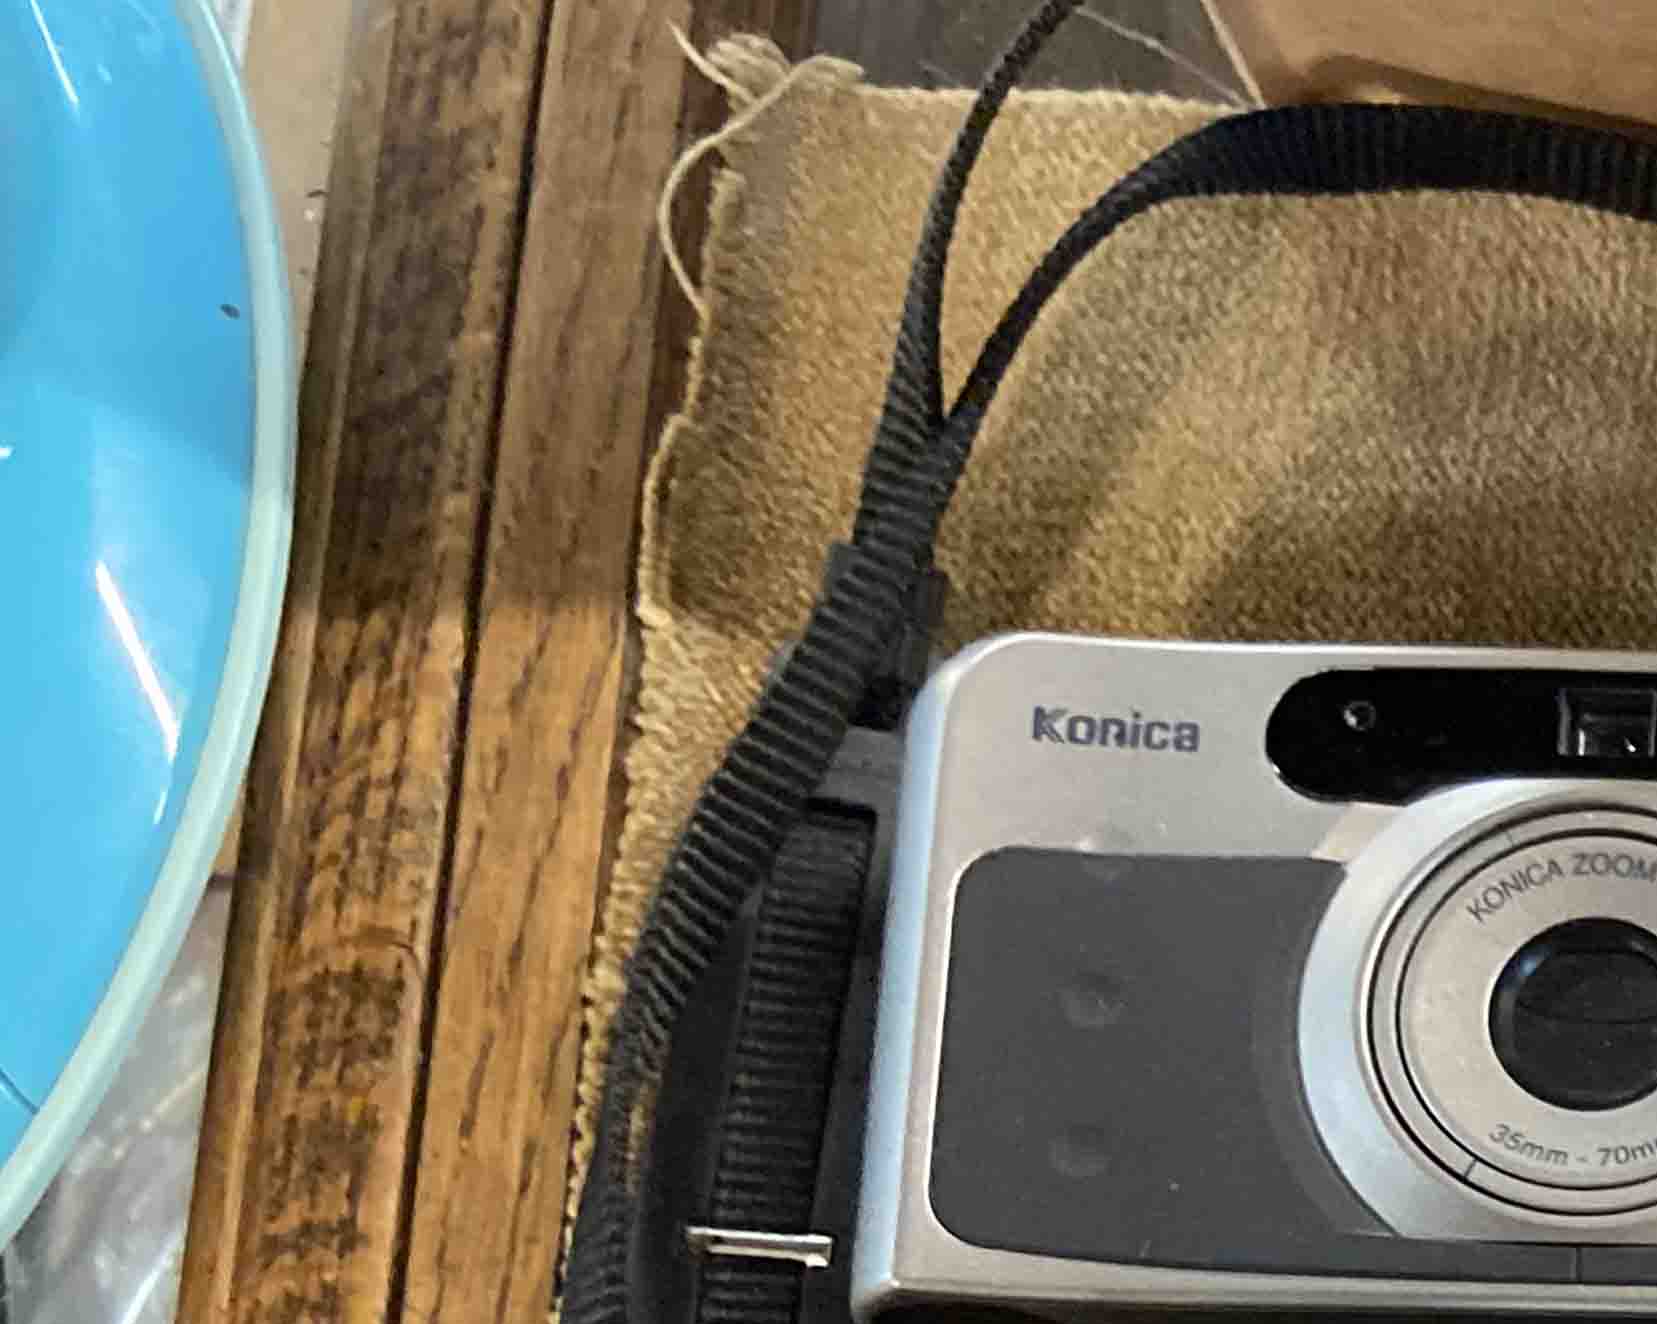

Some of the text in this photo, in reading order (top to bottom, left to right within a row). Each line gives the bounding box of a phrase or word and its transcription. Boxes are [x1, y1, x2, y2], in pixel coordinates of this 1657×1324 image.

[1032, 706, 1200, 752] Konica
[1466, 858, 1564, 923] KONICA
[1488, 1122, 1569, 1166] 35mm
